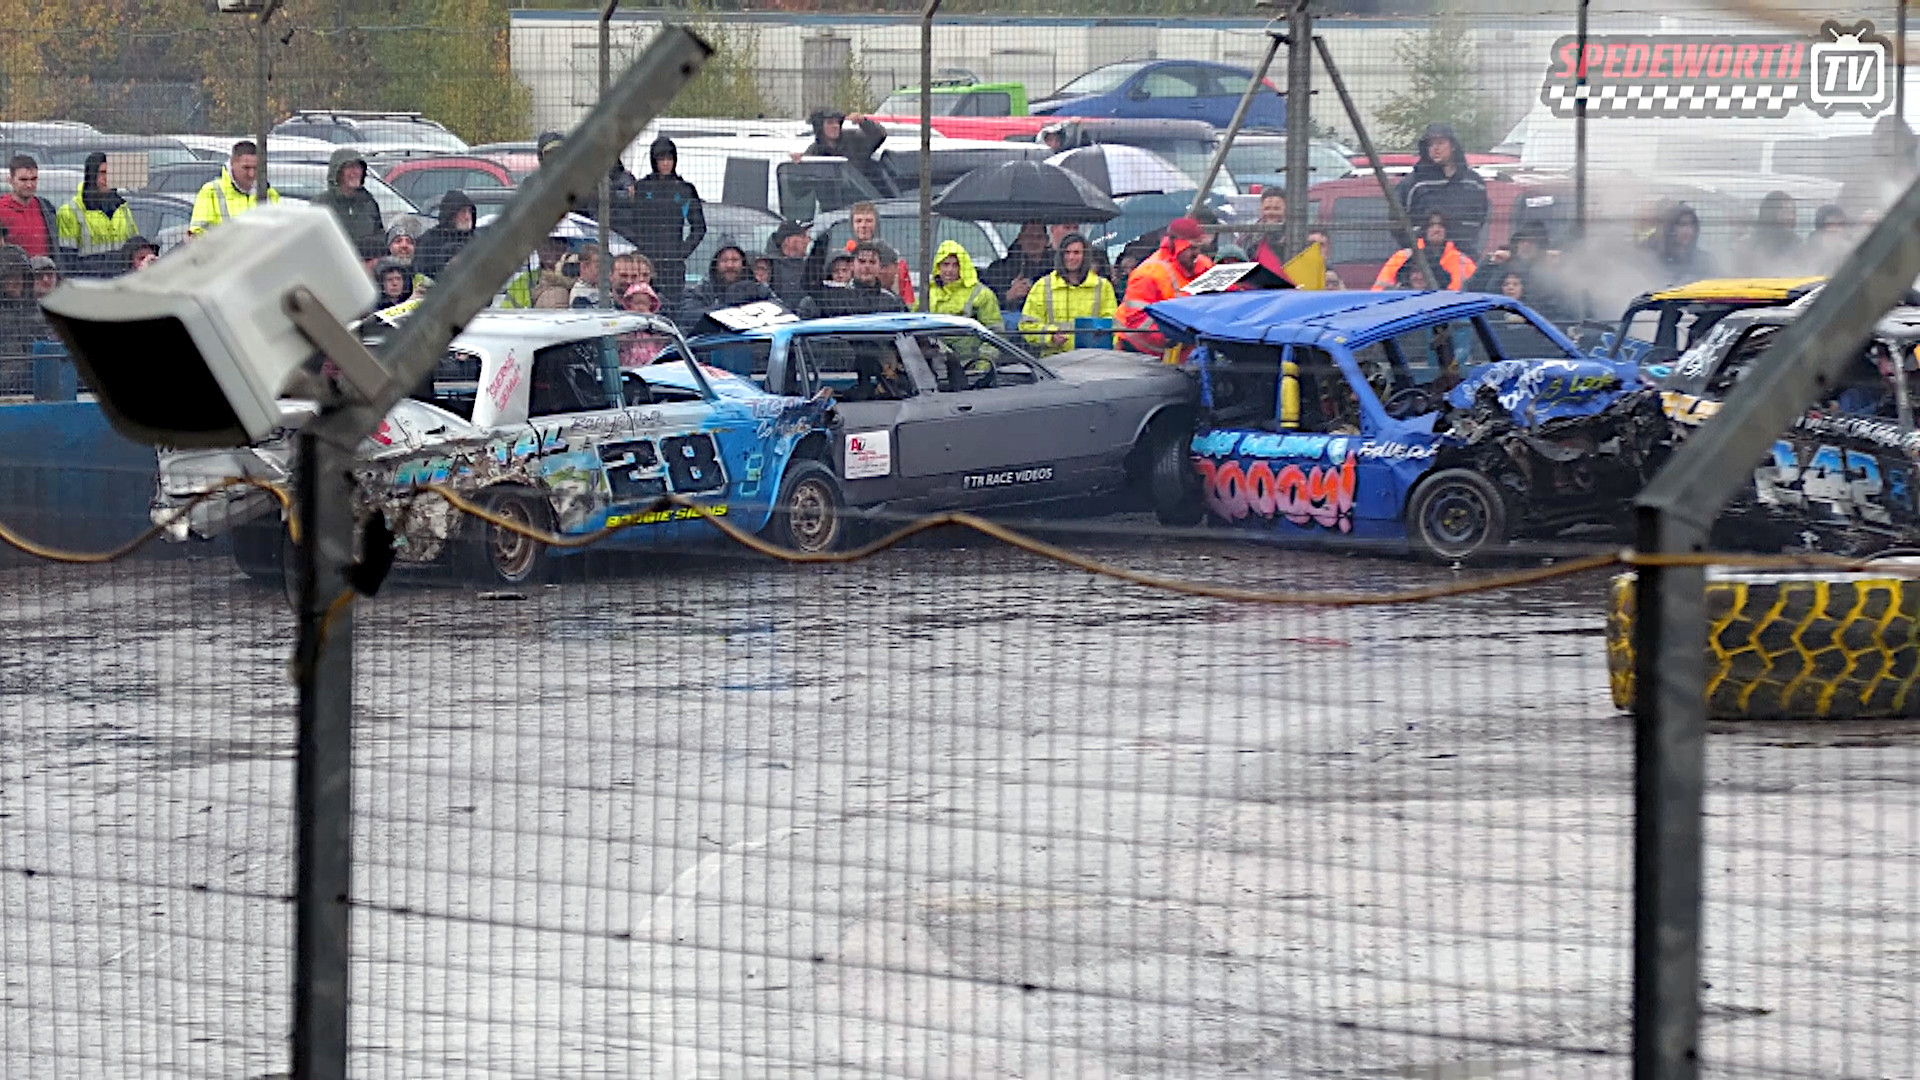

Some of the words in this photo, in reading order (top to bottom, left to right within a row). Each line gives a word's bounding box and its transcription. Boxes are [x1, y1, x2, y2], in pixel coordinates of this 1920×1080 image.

[394, 422, 569, 487] MTAL
[596, 431, 729, 504] 28
[986, 471, 1014, 486] RACE
[1015, 467, 1053, 482] VIDEOS
